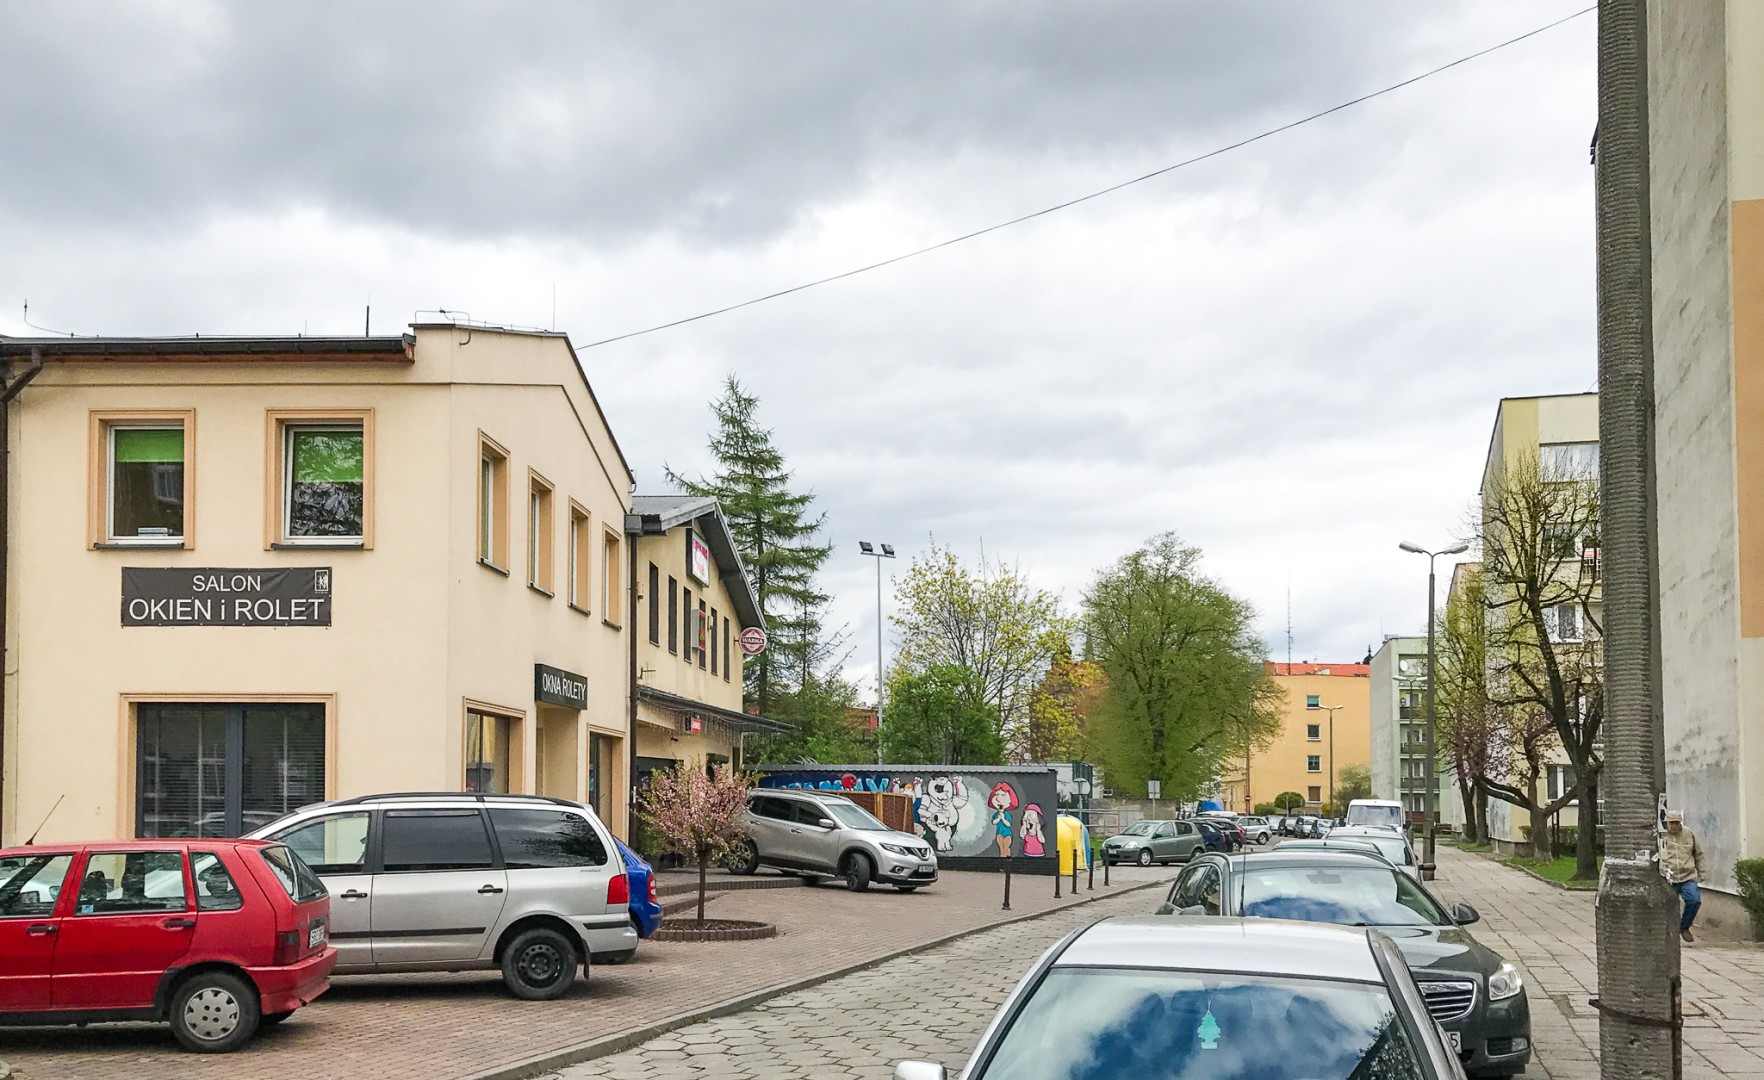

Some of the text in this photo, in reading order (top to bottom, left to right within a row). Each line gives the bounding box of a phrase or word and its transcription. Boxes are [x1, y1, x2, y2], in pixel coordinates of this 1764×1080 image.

[192, 575, 261, 592] SALON
[129, 598, 325, 620] OKIEN i ROLET
[741, 636, 764, 644] WARKA
[542, 673, 586, 701] OKNA ROLETY
